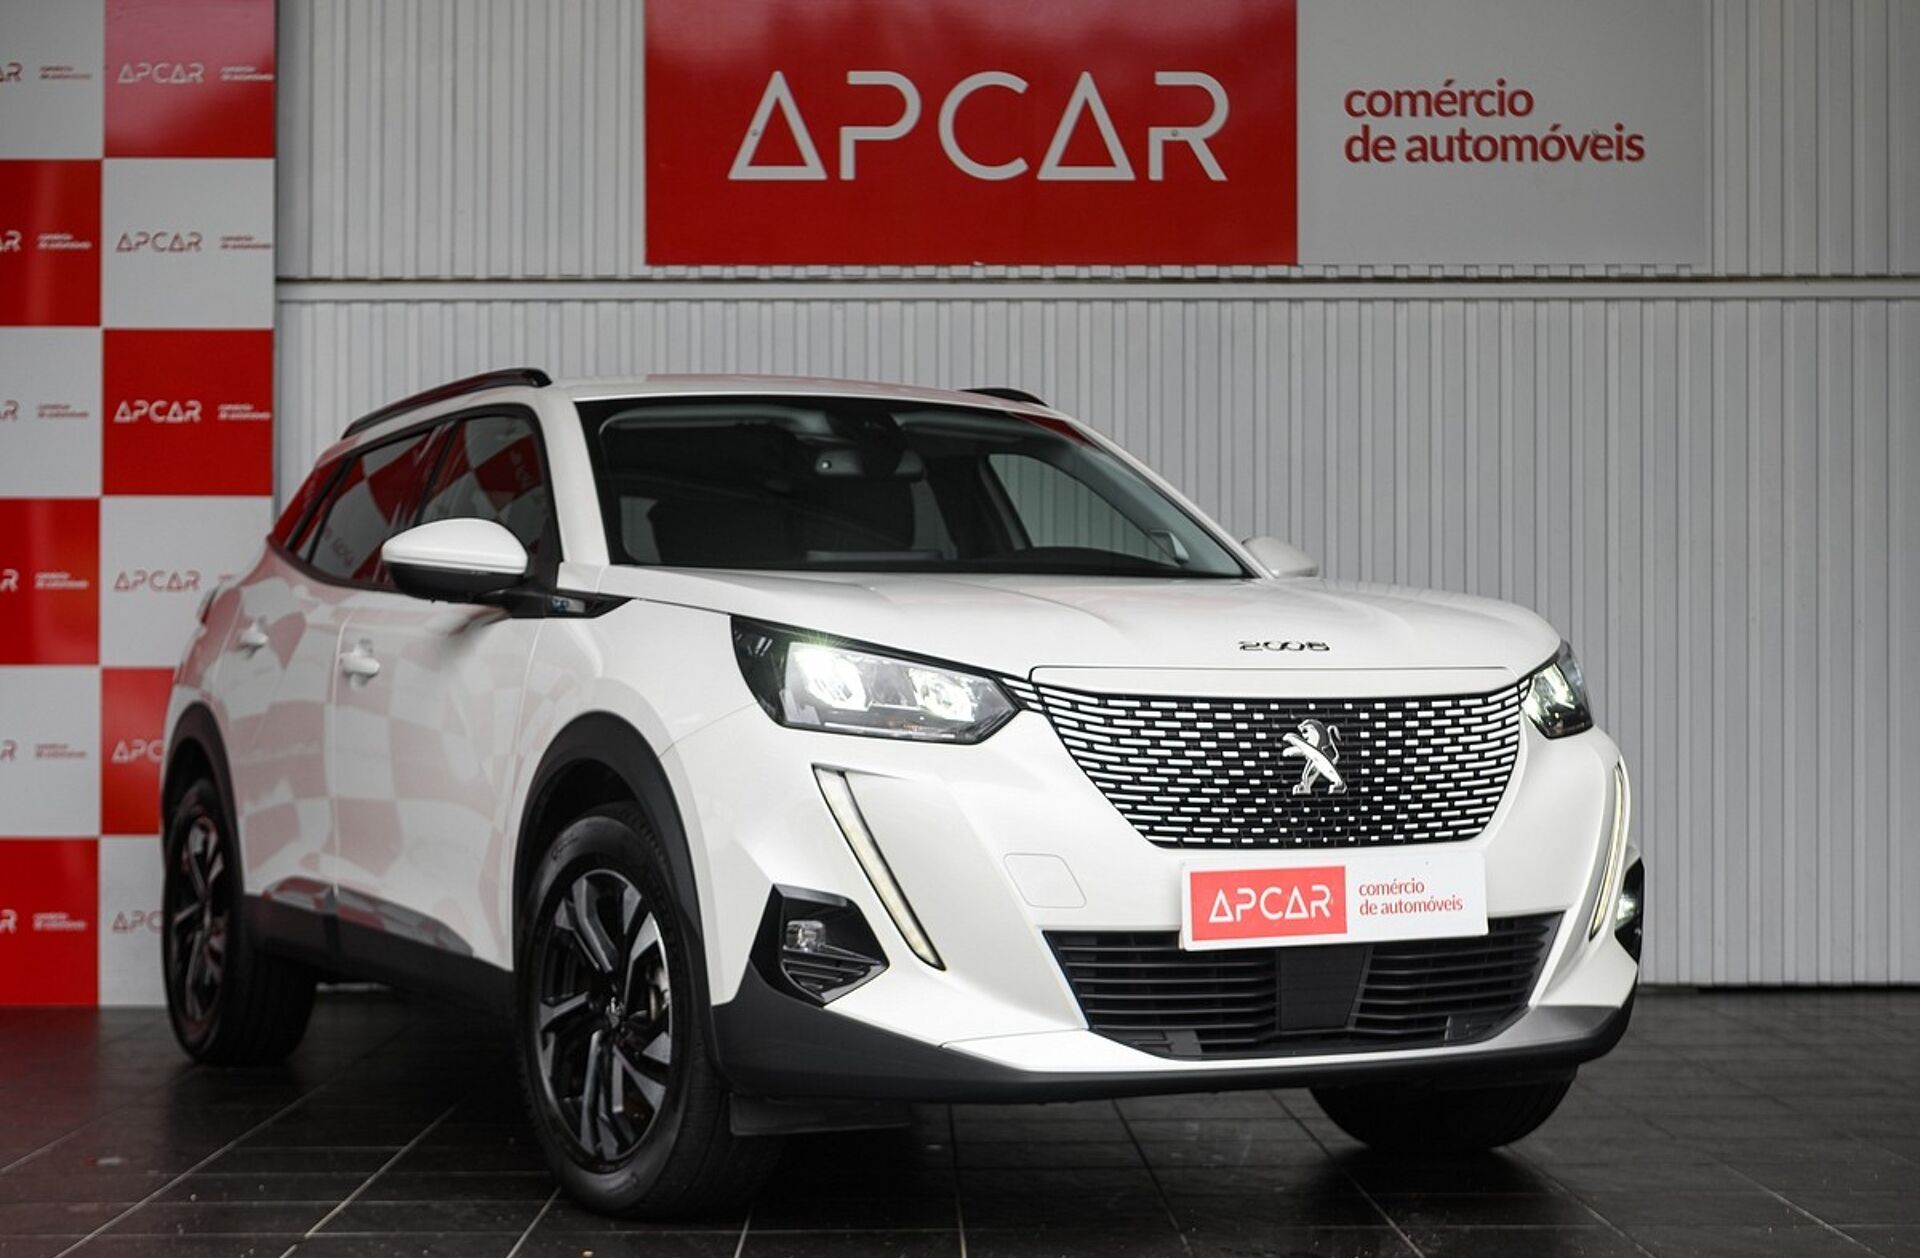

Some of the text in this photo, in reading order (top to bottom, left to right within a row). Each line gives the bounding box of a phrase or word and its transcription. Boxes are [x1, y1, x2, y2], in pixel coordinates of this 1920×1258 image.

[117, 62, 205, 84] APCAR
[1344, 78, 1535, 118] comércio
[728, 70, 1230, 181] APCAR
[1344, 123, 1646, 163] de automóveis
[116, 231, 203, 253] APCAR
[113, 399, 202, 423] APCAR
[113, 569, 201, 592] APCAR
[1358, 877, 1425, 896] comércio
[1208, 884, 1333, 924] APCAR
[1358, 893, 1464, 916] de automóveis
